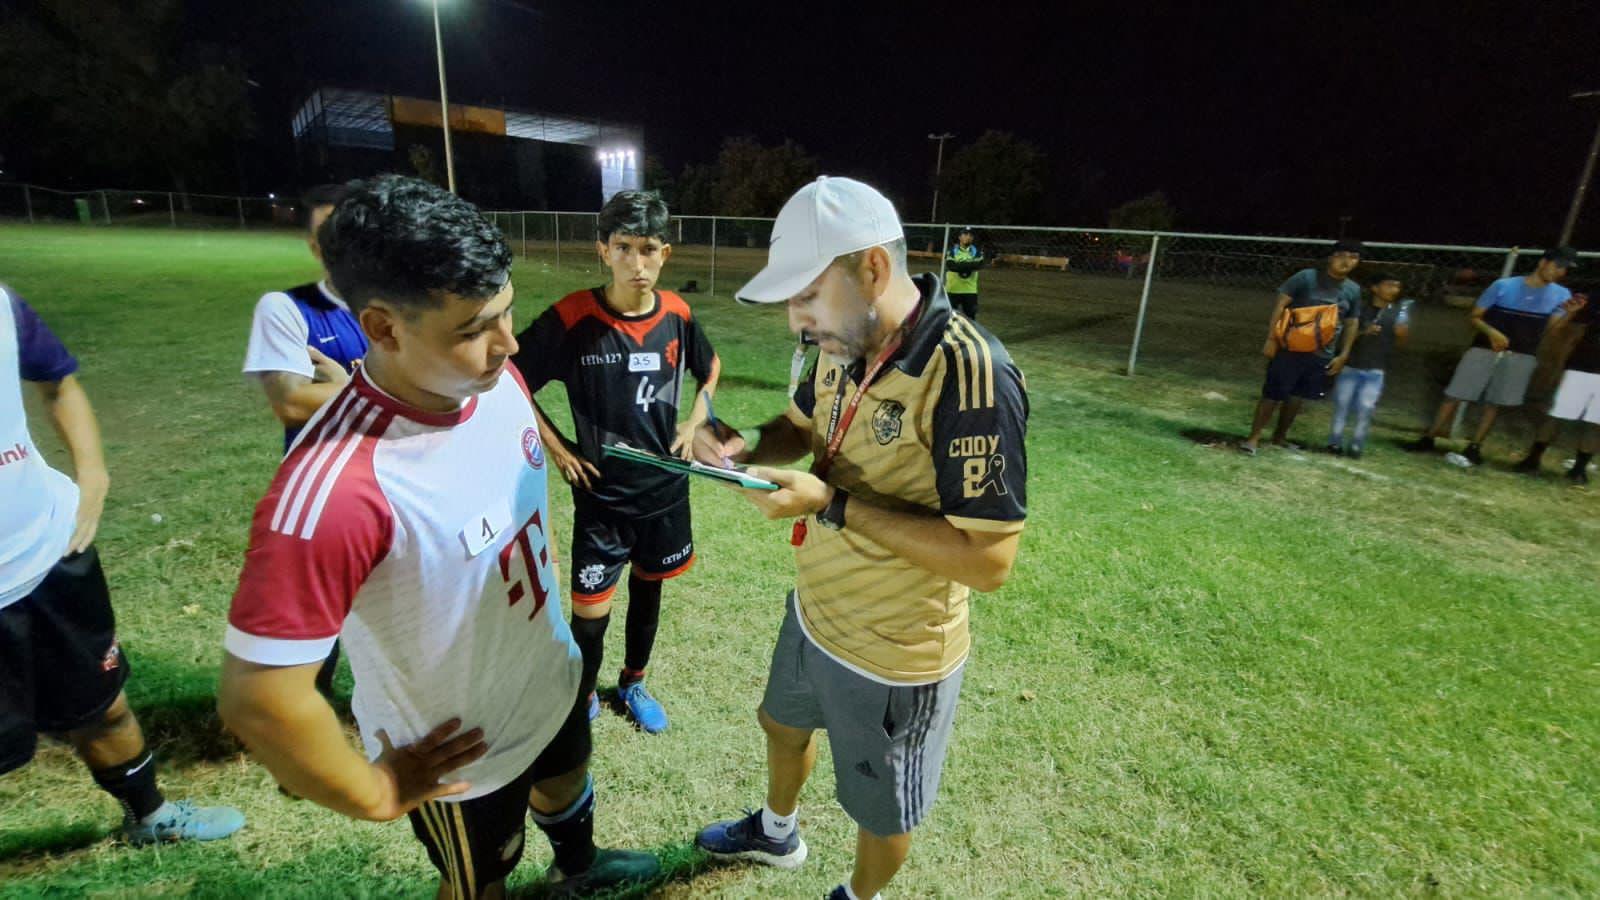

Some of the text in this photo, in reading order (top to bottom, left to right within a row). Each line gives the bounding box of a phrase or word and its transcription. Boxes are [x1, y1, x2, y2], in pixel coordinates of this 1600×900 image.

[606, 353, 622, 364] 127
[636, 376, 656, 412] 4
[949, 434, 1000, 457] CODY
[963, 458, 986, 498] 8
[481, 517, 499, 545] 1
